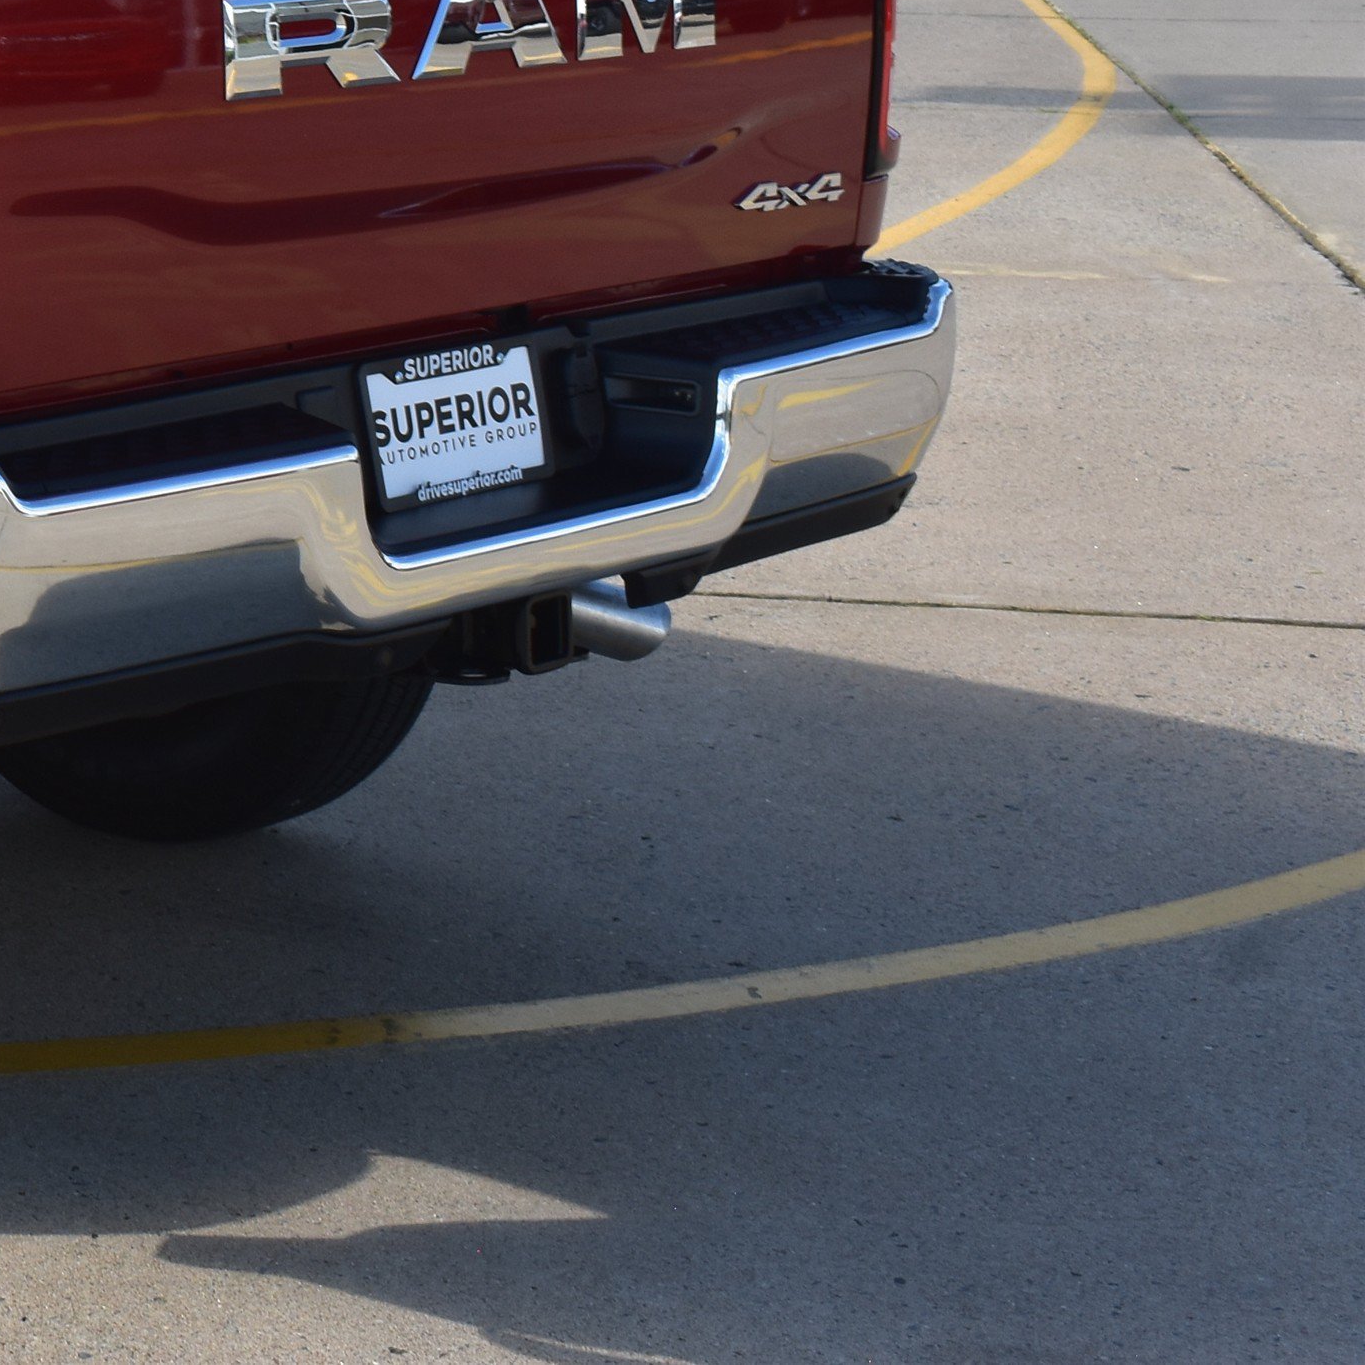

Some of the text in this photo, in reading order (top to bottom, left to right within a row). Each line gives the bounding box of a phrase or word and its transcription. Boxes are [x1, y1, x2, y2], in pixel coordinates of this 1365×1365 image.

[403, 344, 495, 381] SUPERIOR
[372, 382, 537, 448] SUPERIOR
[485, 421, 538, 445] GROUP
[417, 465, 523, 502] drivesuperior.com
